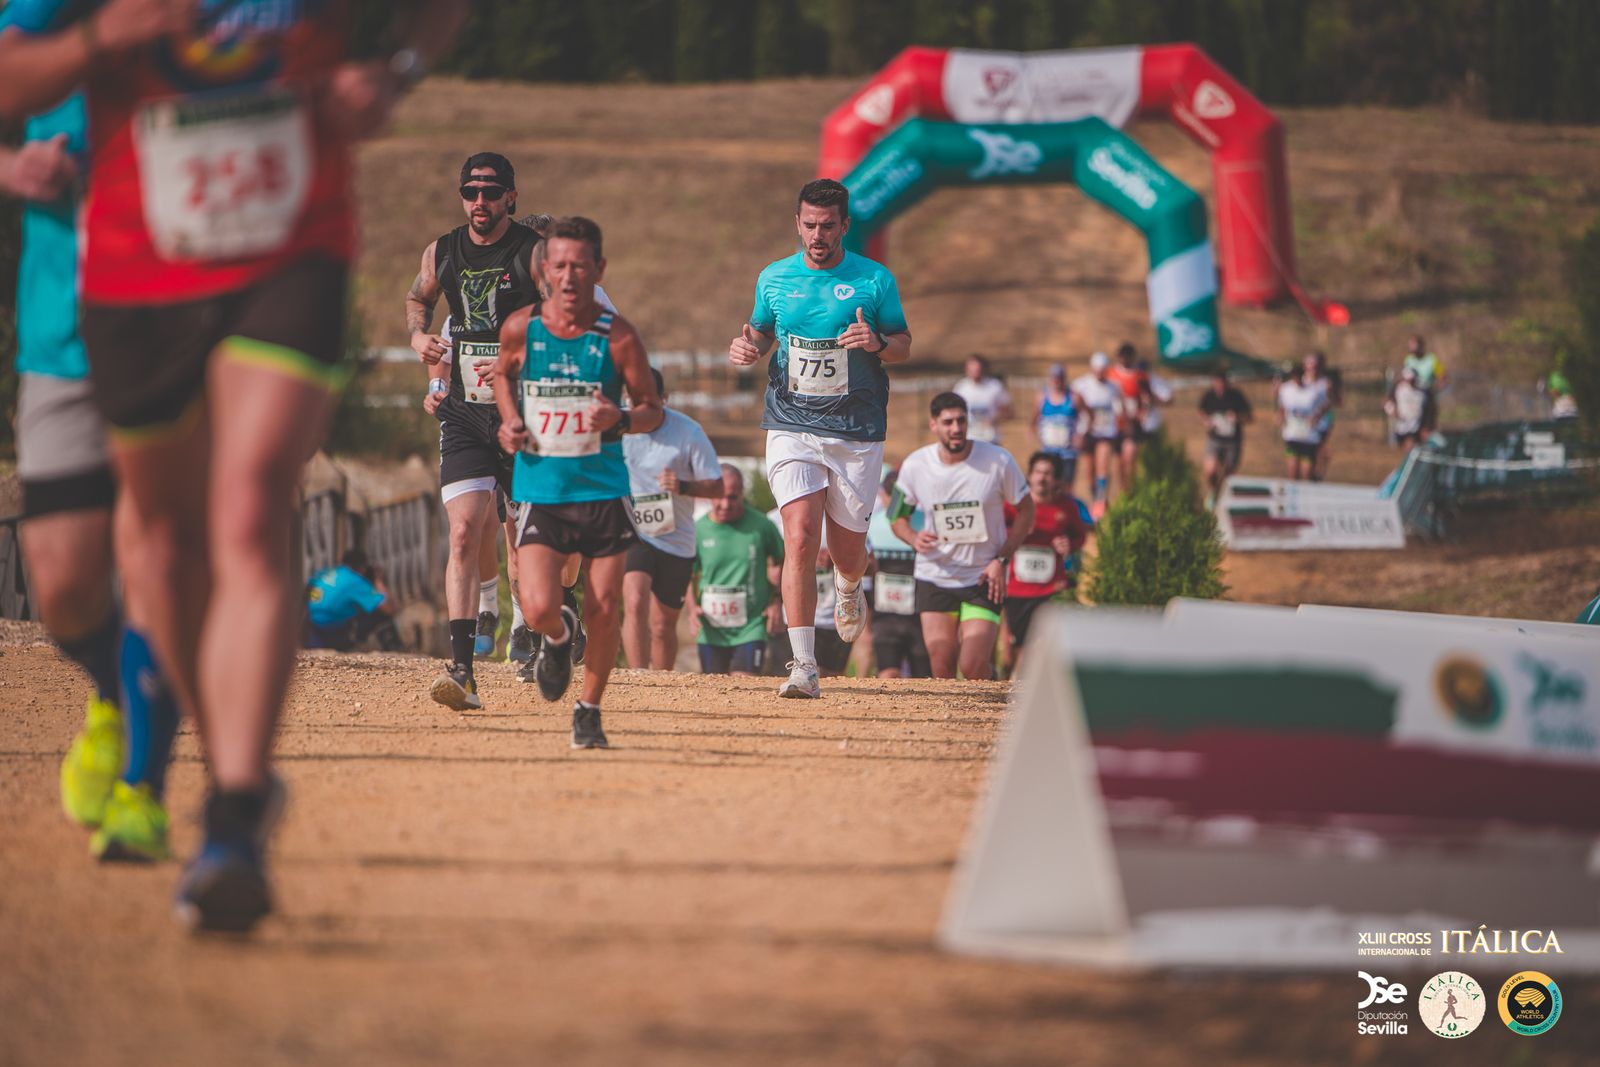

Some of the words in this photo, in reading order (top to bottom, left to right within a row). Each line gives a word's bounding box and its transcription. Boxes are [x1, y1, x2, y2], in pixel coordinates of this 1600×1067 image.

[798, 357, 837, 378] 775
[538, 411, 587, 435] 771
[633, 508, 664, 525] 860
[945, 515, 974, 531] 557
